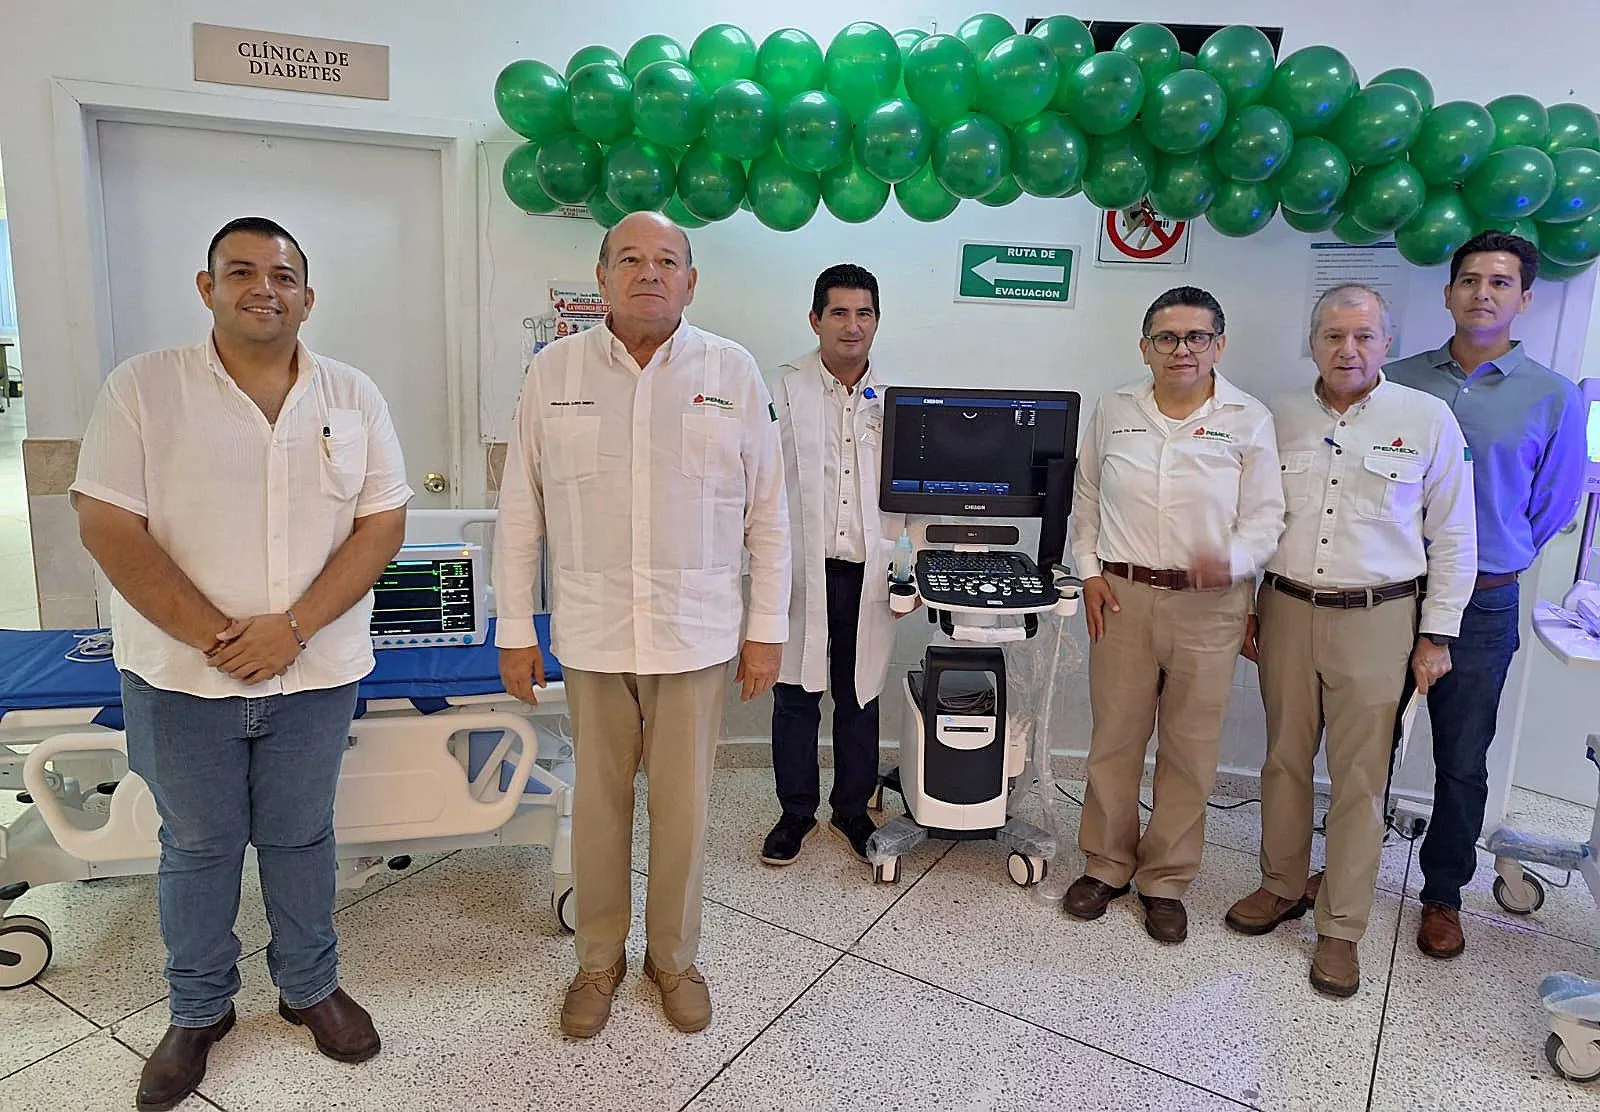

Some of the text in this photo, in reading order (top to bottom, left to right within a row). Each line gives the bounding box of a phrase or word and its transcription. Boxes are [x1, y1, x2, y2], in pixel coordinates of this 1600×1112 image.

[238, 41, 349, 67] CLÍNICA DE
[249, 60, 342, 82] DIABETES
[1007, 248, 1056, 259] RUTA DE
[995, 287, 1060, 298] EVACUACIÓN
[1206, 430, 1231, 439] PEMEX
[1373, 445, 1416, 454] PEMEX
